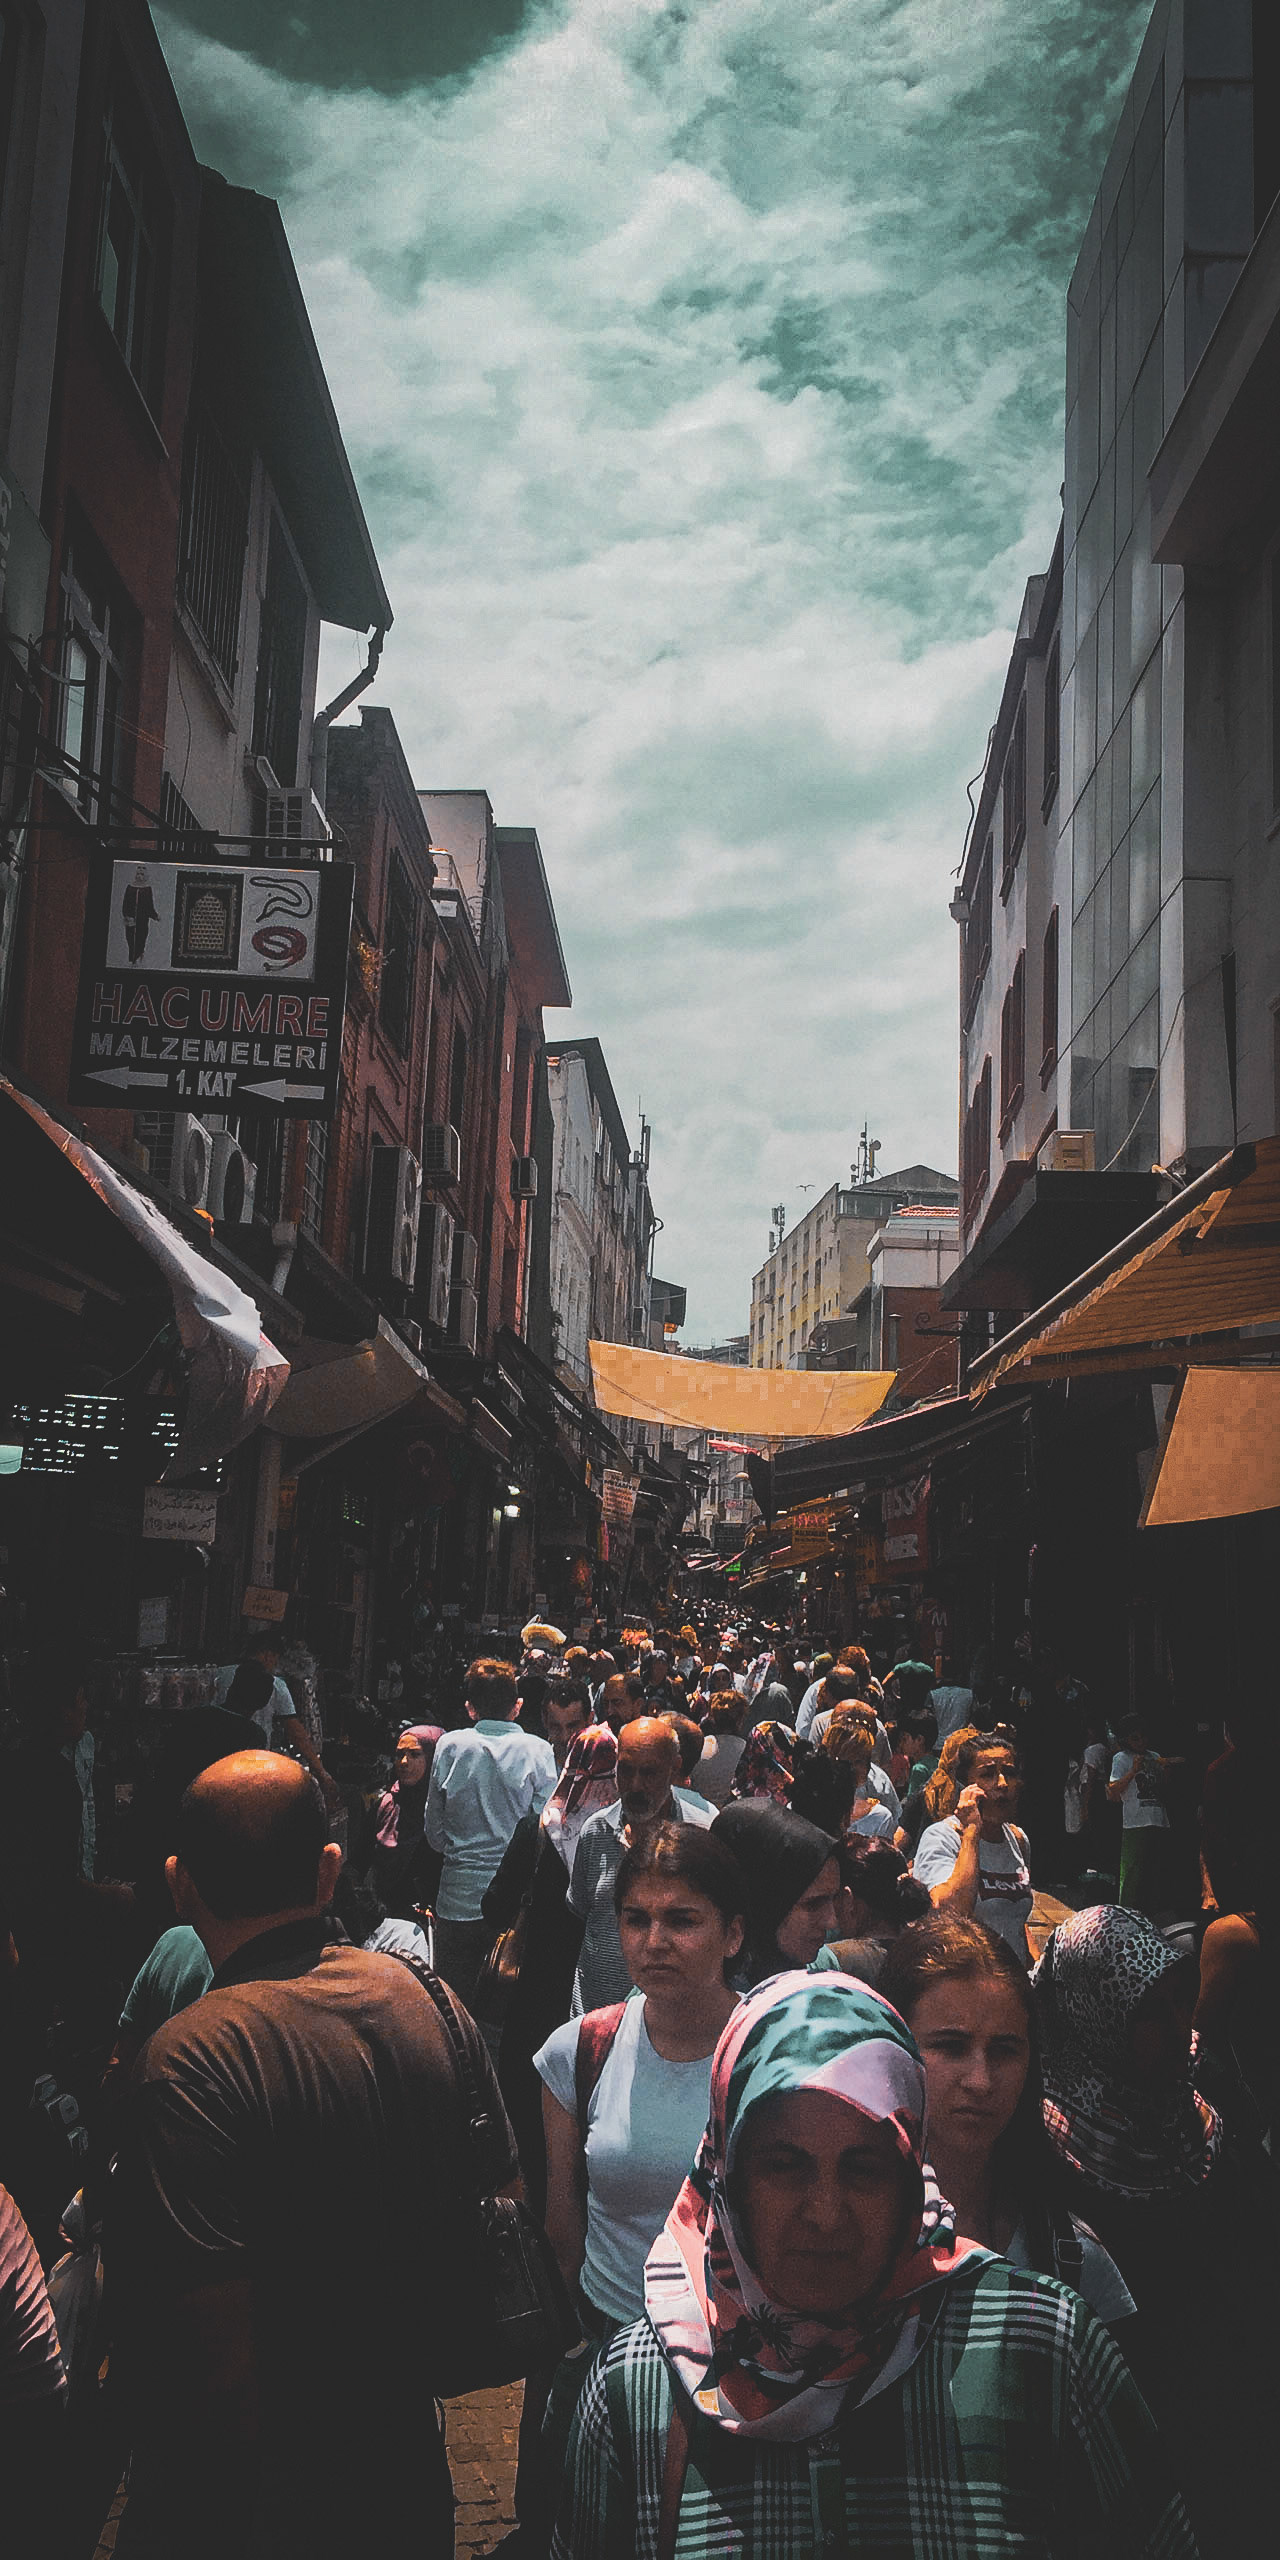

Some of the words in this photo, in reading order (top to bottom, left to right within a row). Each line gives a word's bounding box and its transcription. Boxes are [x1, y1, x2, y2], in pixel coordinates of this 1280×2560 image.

[92, 982, 190, 1029] HAC
[200, 990, 330, 1038] UMRE
[89, 1032, 328, 1071] MALZEMELERİ
[176, 1069, 191, 1095] 1.
[197, 1070, 237, 1098] KAT
